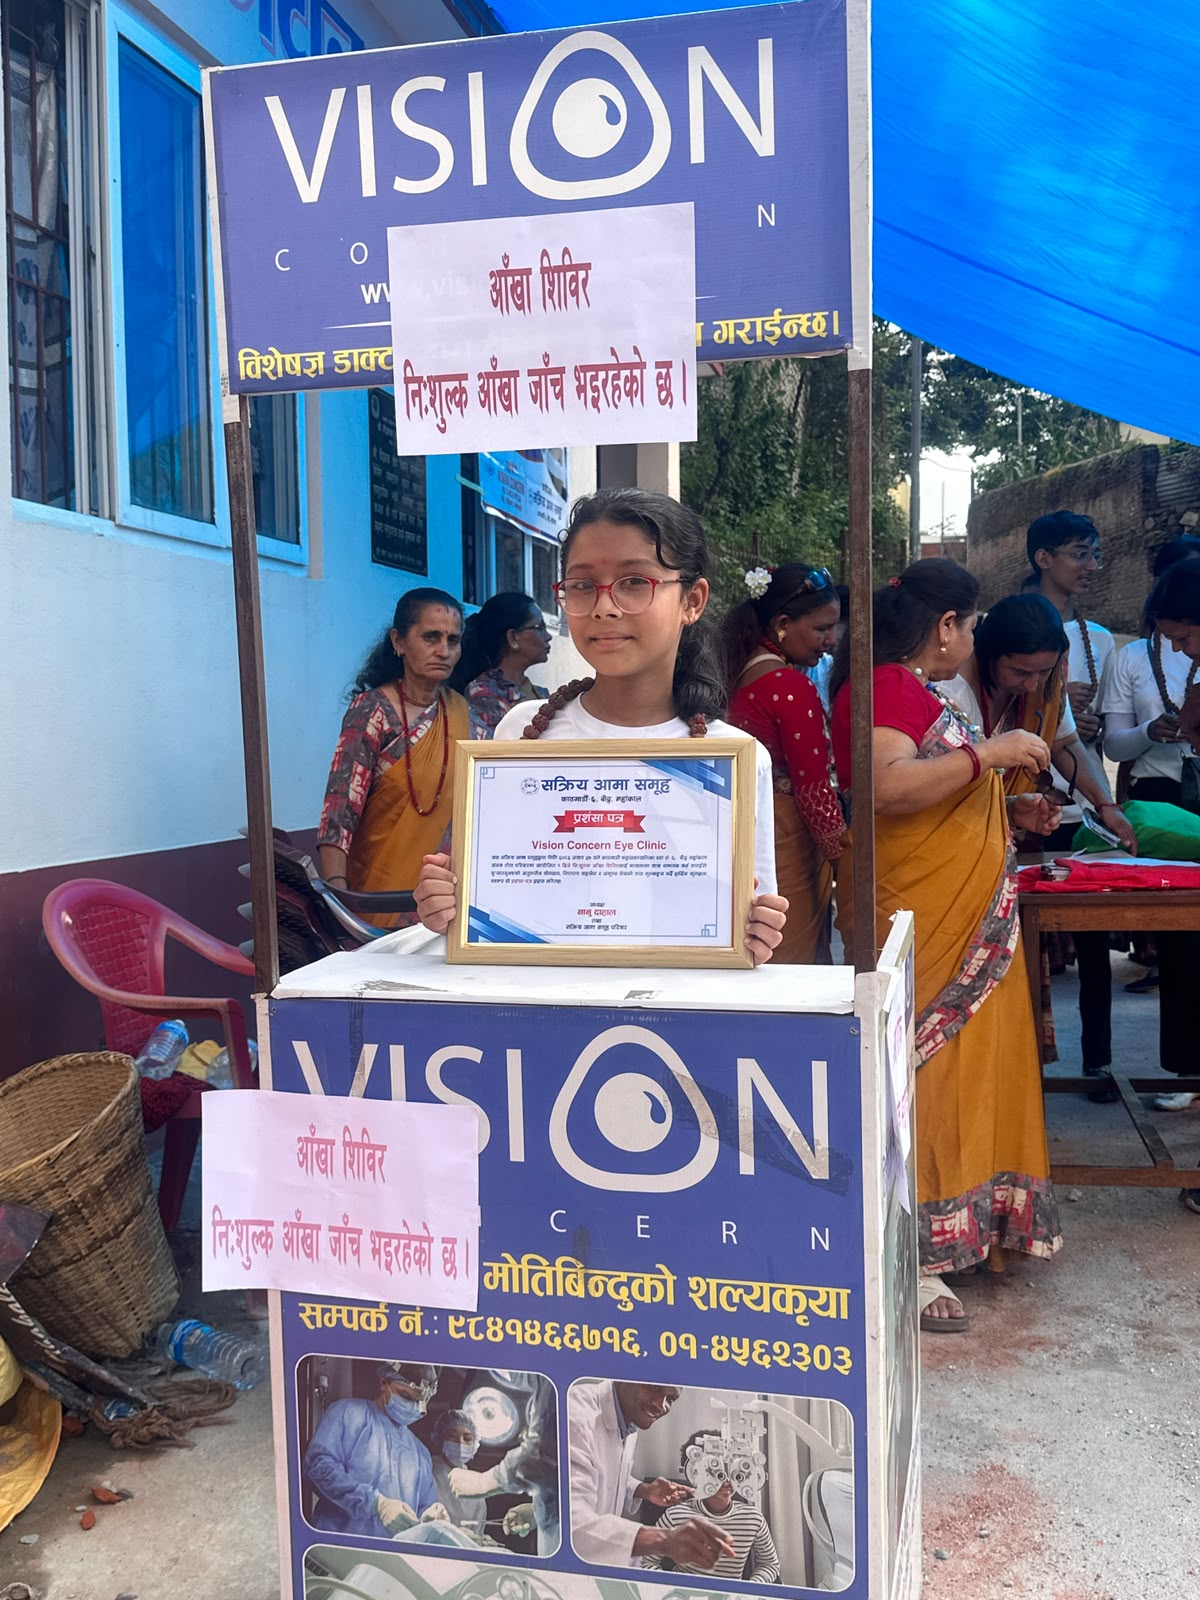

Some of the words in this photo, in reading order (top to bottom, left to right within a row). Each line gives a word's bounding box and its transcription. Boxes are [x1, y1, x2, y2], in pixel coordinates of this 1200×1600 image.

[264, 31, 775, 203] VISION
[489, 252, 532, 317] आँखा
[540, 246, 592, 313] शिविर
[238, 347, 326, 381] विशेषज्ञ
[477, 355, 520, 418] आँखा
[527, 351, 566, 414] जाँच
[574, 345, 647, 414] भइरहेको
[541, 776, 589, 792] सक्रिय
[593, 779, 630, 791] आमा
[634, 778, 672, 795] समूह
[532, 840, 564, 850] Vision
[567, 840, 611, 850] Concern
[614, 840, 634, 852] Eye
[636, 840, 667, 850] Clinic
[573, 811, 605, 824] प्रशंसा
[607, 813, 625, 824] पत्र
[297, 1122, 336, 1180] आँखा
[342, 1125, 387, 1184] शिविर
[282, 1208, 321, 1263] आँखा
[328, 1213, 363, 1268] जाँच
[370, 1219, 434, 1277] भइरहेको
[298, 1302, 389, 1332] सम्पर्क
[483, 1252, 677, 1312] मोतिबिन्दुको
[688, 1276, 851, 1327] शल्यकृया
